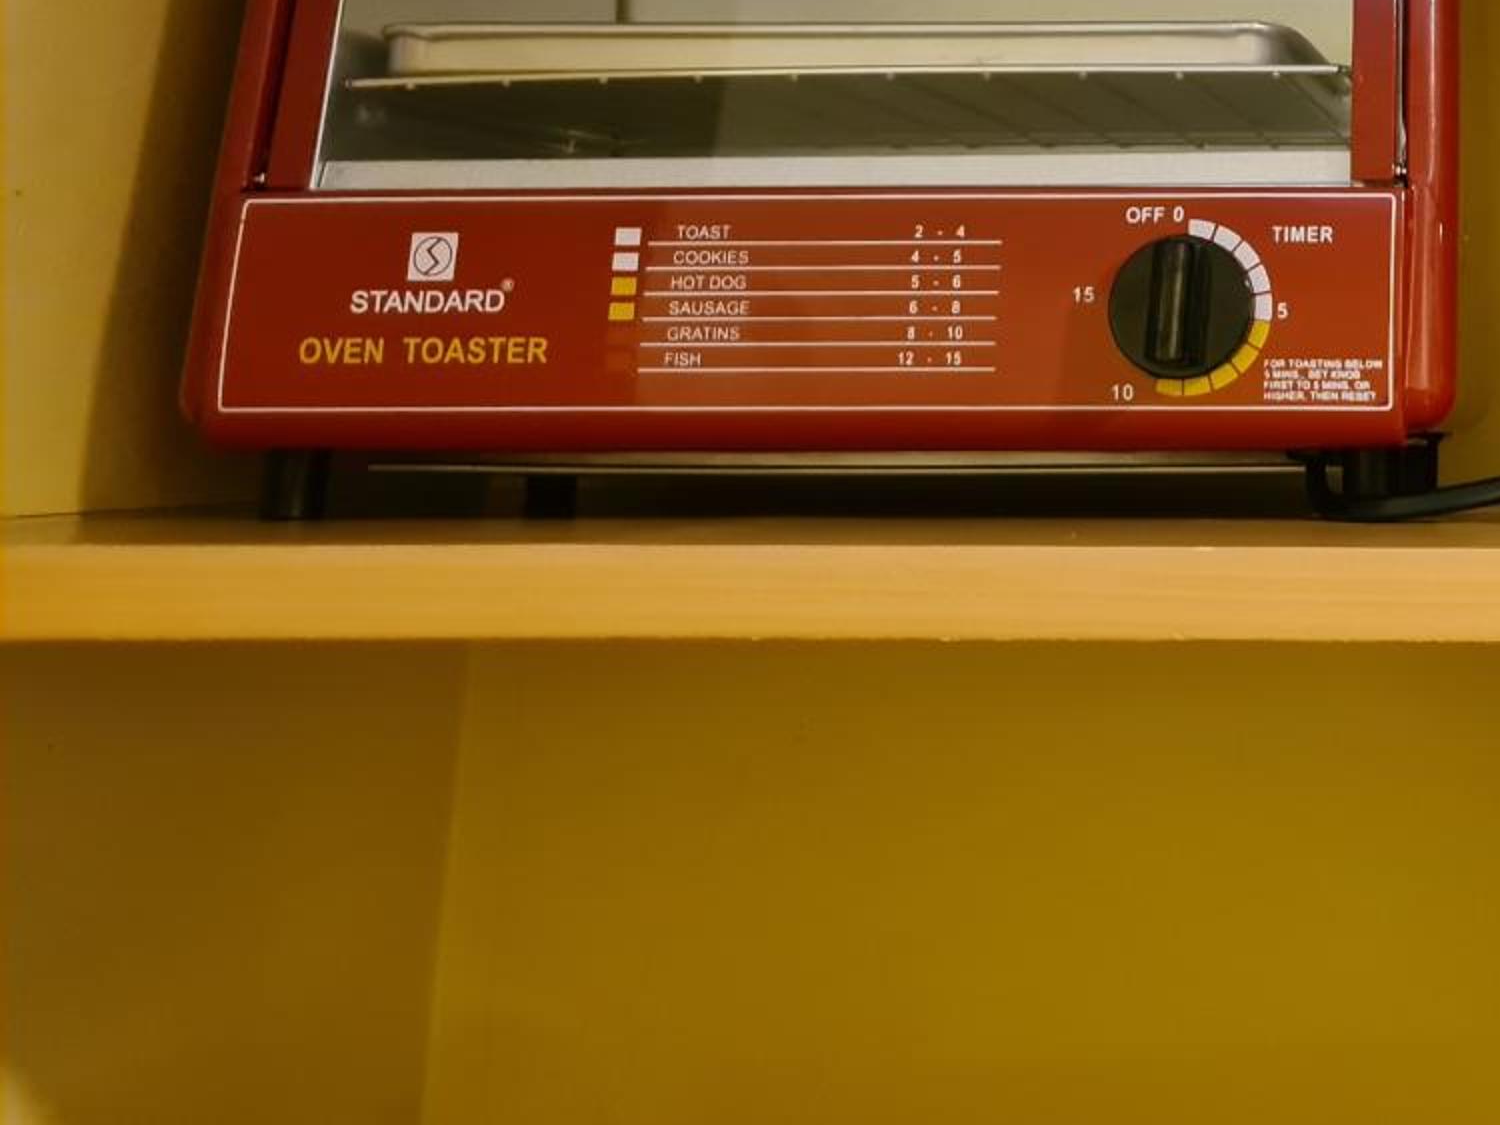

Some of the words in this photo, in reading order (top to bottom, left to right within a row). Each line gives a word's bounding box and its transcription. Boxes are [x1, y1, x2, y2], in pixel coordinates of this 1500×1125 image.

[1125, 207, 1165, 223] OFF
[1173, 206, 1185, 222] 0
[677, 225, 731, 240] TOAST
[915, 224, 923, 238] 2
[956, 225, 965, 237] 4
[1272, 226, 1333, 243] TIMER
[673, 250, 749, 265] COOKIES
[911, 249, 919, 263] 4
[953, 249, 961, 264] 5
[671, 275, 704, 290] HOT
[709, 275, 747, 290] DOG
[911, 275, 919, 289] 5
[350, 290, 505, 313] STANDARD
[1073, 287, 1095, 303] 15
[669, 300, 751, 315] SAUSAGE
[909, 300, 918, 314] 6
[1277, 303, 1288, 318] 5
[667, 326, 740, 341] GRATINS
[948, 326, 963, 340] 10
[299, 337, 384, 364] OVEN
[403, 337, 548, 364] TOASTER
[664, 352, 702, 366] FISH
[899, 350, 914, 365] 12
[946, 350, 961, 365] 15
[1111, 384, 1133, 400] 10
